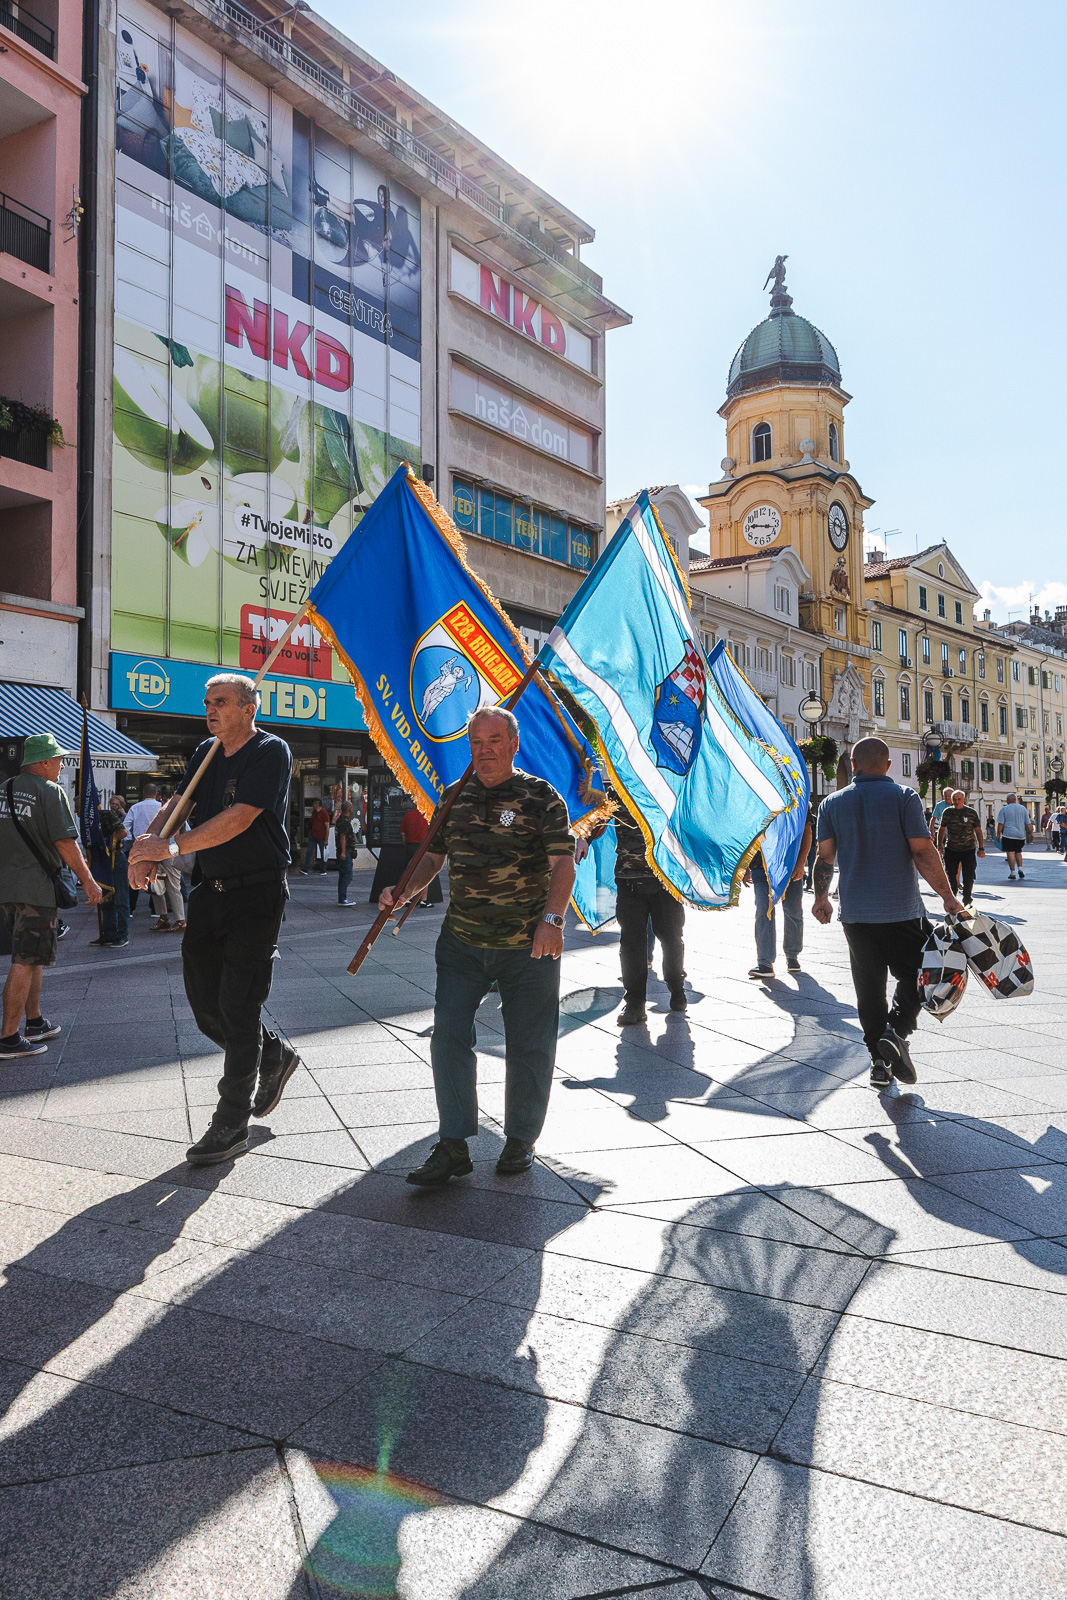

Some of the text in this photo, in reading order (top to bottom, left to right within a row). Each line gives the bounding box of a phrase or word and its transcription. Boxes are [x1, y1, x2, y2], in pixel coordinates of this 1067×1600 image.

[151, 192, 260, 265] naš dom
[480, 265, 567, 356] NKD
[225, 283, 354, 392] NKD
[474, 392, 568, 458] naš dom
[453, 496, 476, 518] TEDi
[241, 513, 333, 549] #TvojeMisto
[516, 519, 538, 541] TEDi
[237, 541, 331, 580] ZA DNEVN
[572, 541, 591, 559] TEDi
[259, 577, 312, 606] SVJEŽ
[449, 611, 519, 692] 128. BRIGADA
[126, 671, 171, 697] TEDi
[256, 679, 327, 722] TEDi
[376, 674, 445, 796] SV. VID-RIJEKA
[91, 758, 128, 769] CENTAR
